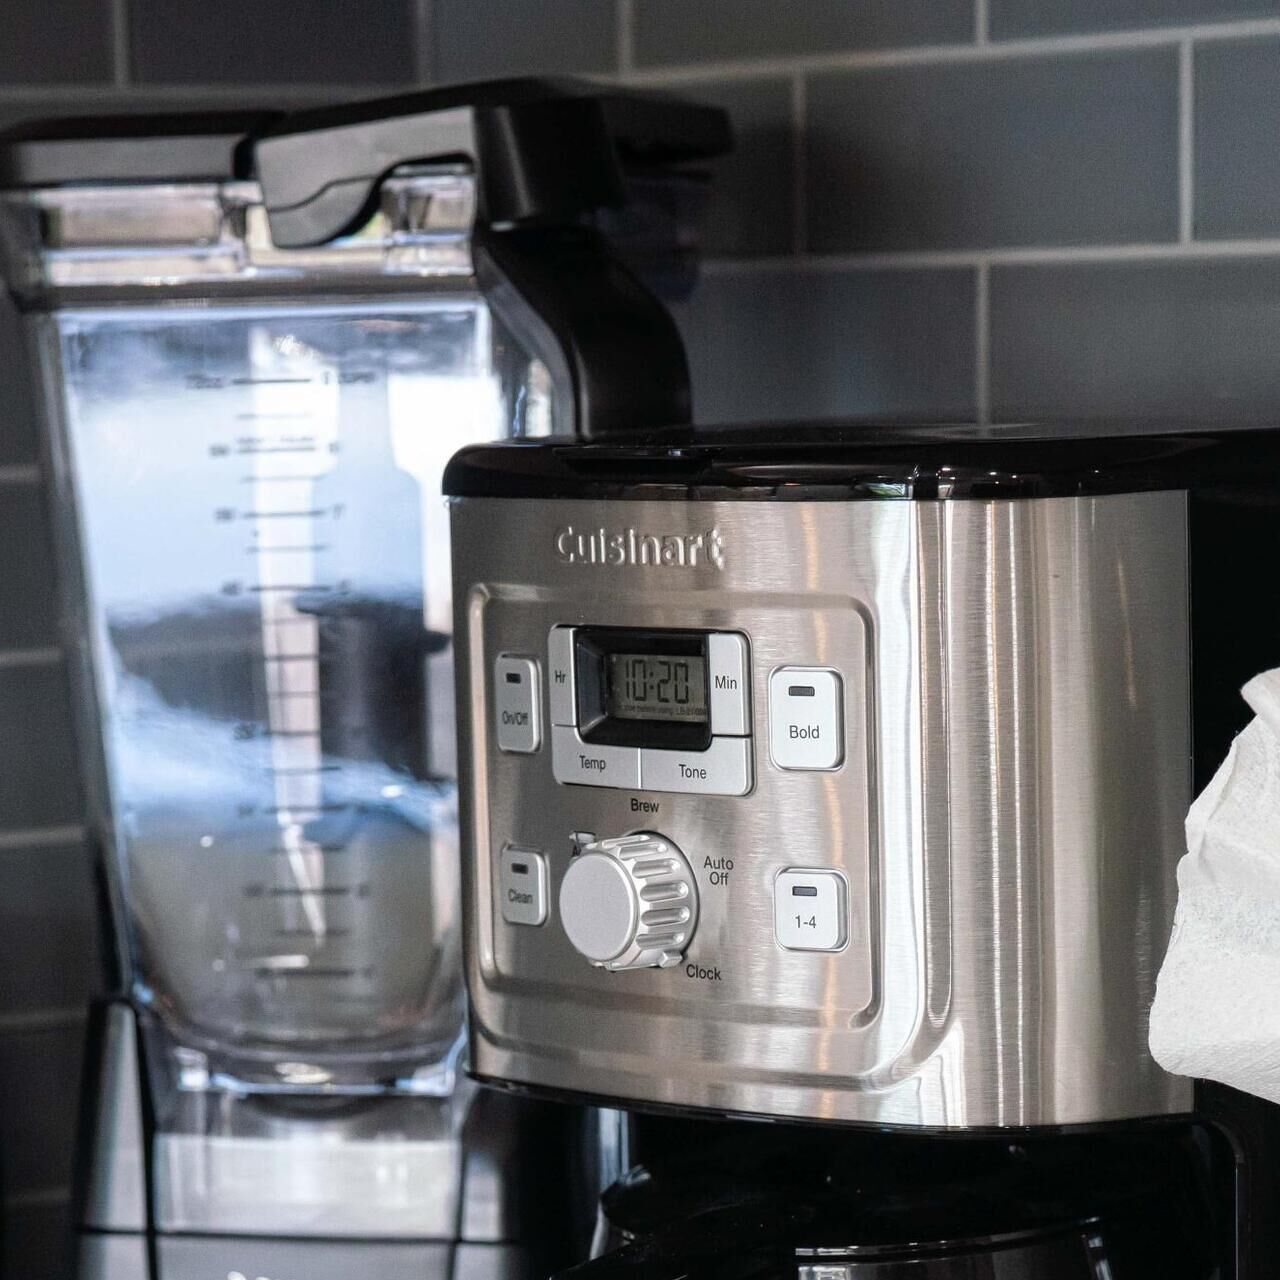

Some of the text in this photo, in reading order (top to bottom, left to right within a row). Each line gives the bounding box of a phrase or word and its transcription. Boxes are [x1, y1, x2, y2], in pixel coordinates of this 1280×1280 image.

[555, 524, 724, 570] Cuisinart
[554, 670, 567, 683] Hr
[626, 659, 690, 704] 10:20
[714, 675, 738, 690] Min
[501, 710, 528, 726] On/Off
[789, 724, 820, 739] Bold
[579, 755, 607, 771] Temp
[679, 764, 707, 779] Tone
[630, 798, 660, 813] Brew
[704, 855, 734, 871] Auto
[709, 871, 729, 886] Off
[508, 888, 533, 904] Clean
[794, 915, 817, 929] 1-4
[686, 963, 722, 981] Clock
